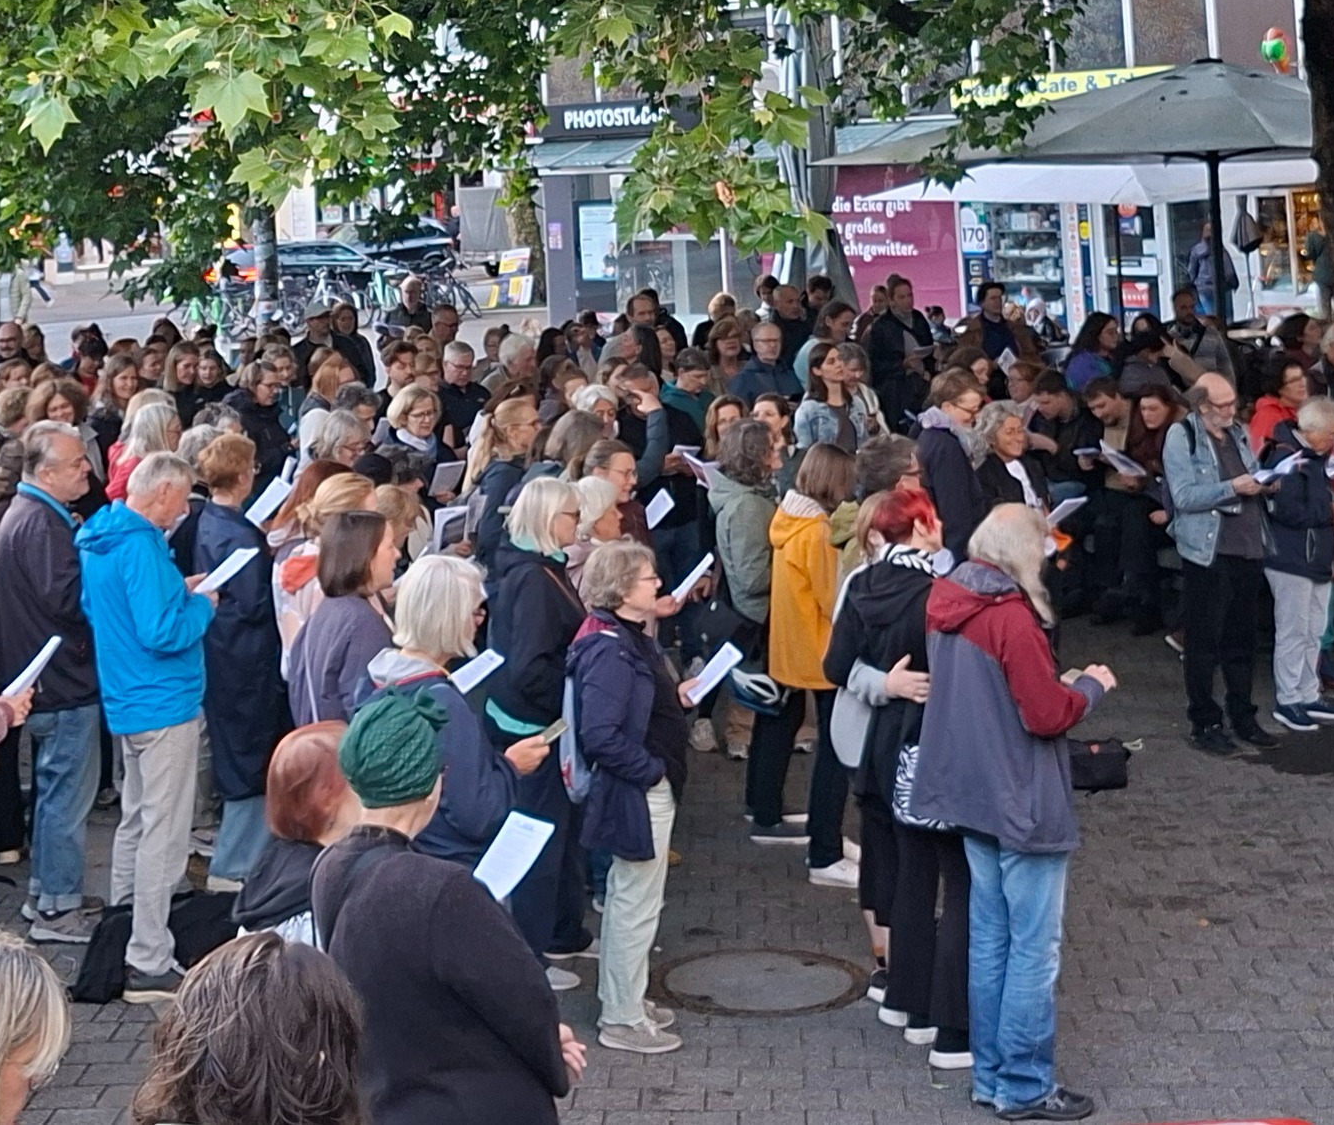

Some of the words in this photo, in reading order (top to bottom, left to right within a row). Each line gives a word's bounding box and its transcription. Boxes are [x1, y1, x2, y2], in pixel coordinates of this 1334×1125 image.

[1035, 77, 1078, 94] Cafe
[831, 196, 852, 213] die
[853, 196, 884, 213] Ecke
[885, 200, 912, 218] gibt
[845, 217, 886, 240] großes
[962, 227, 984, 243] 170
[841, 240, 919, 263] chtgewitter.
